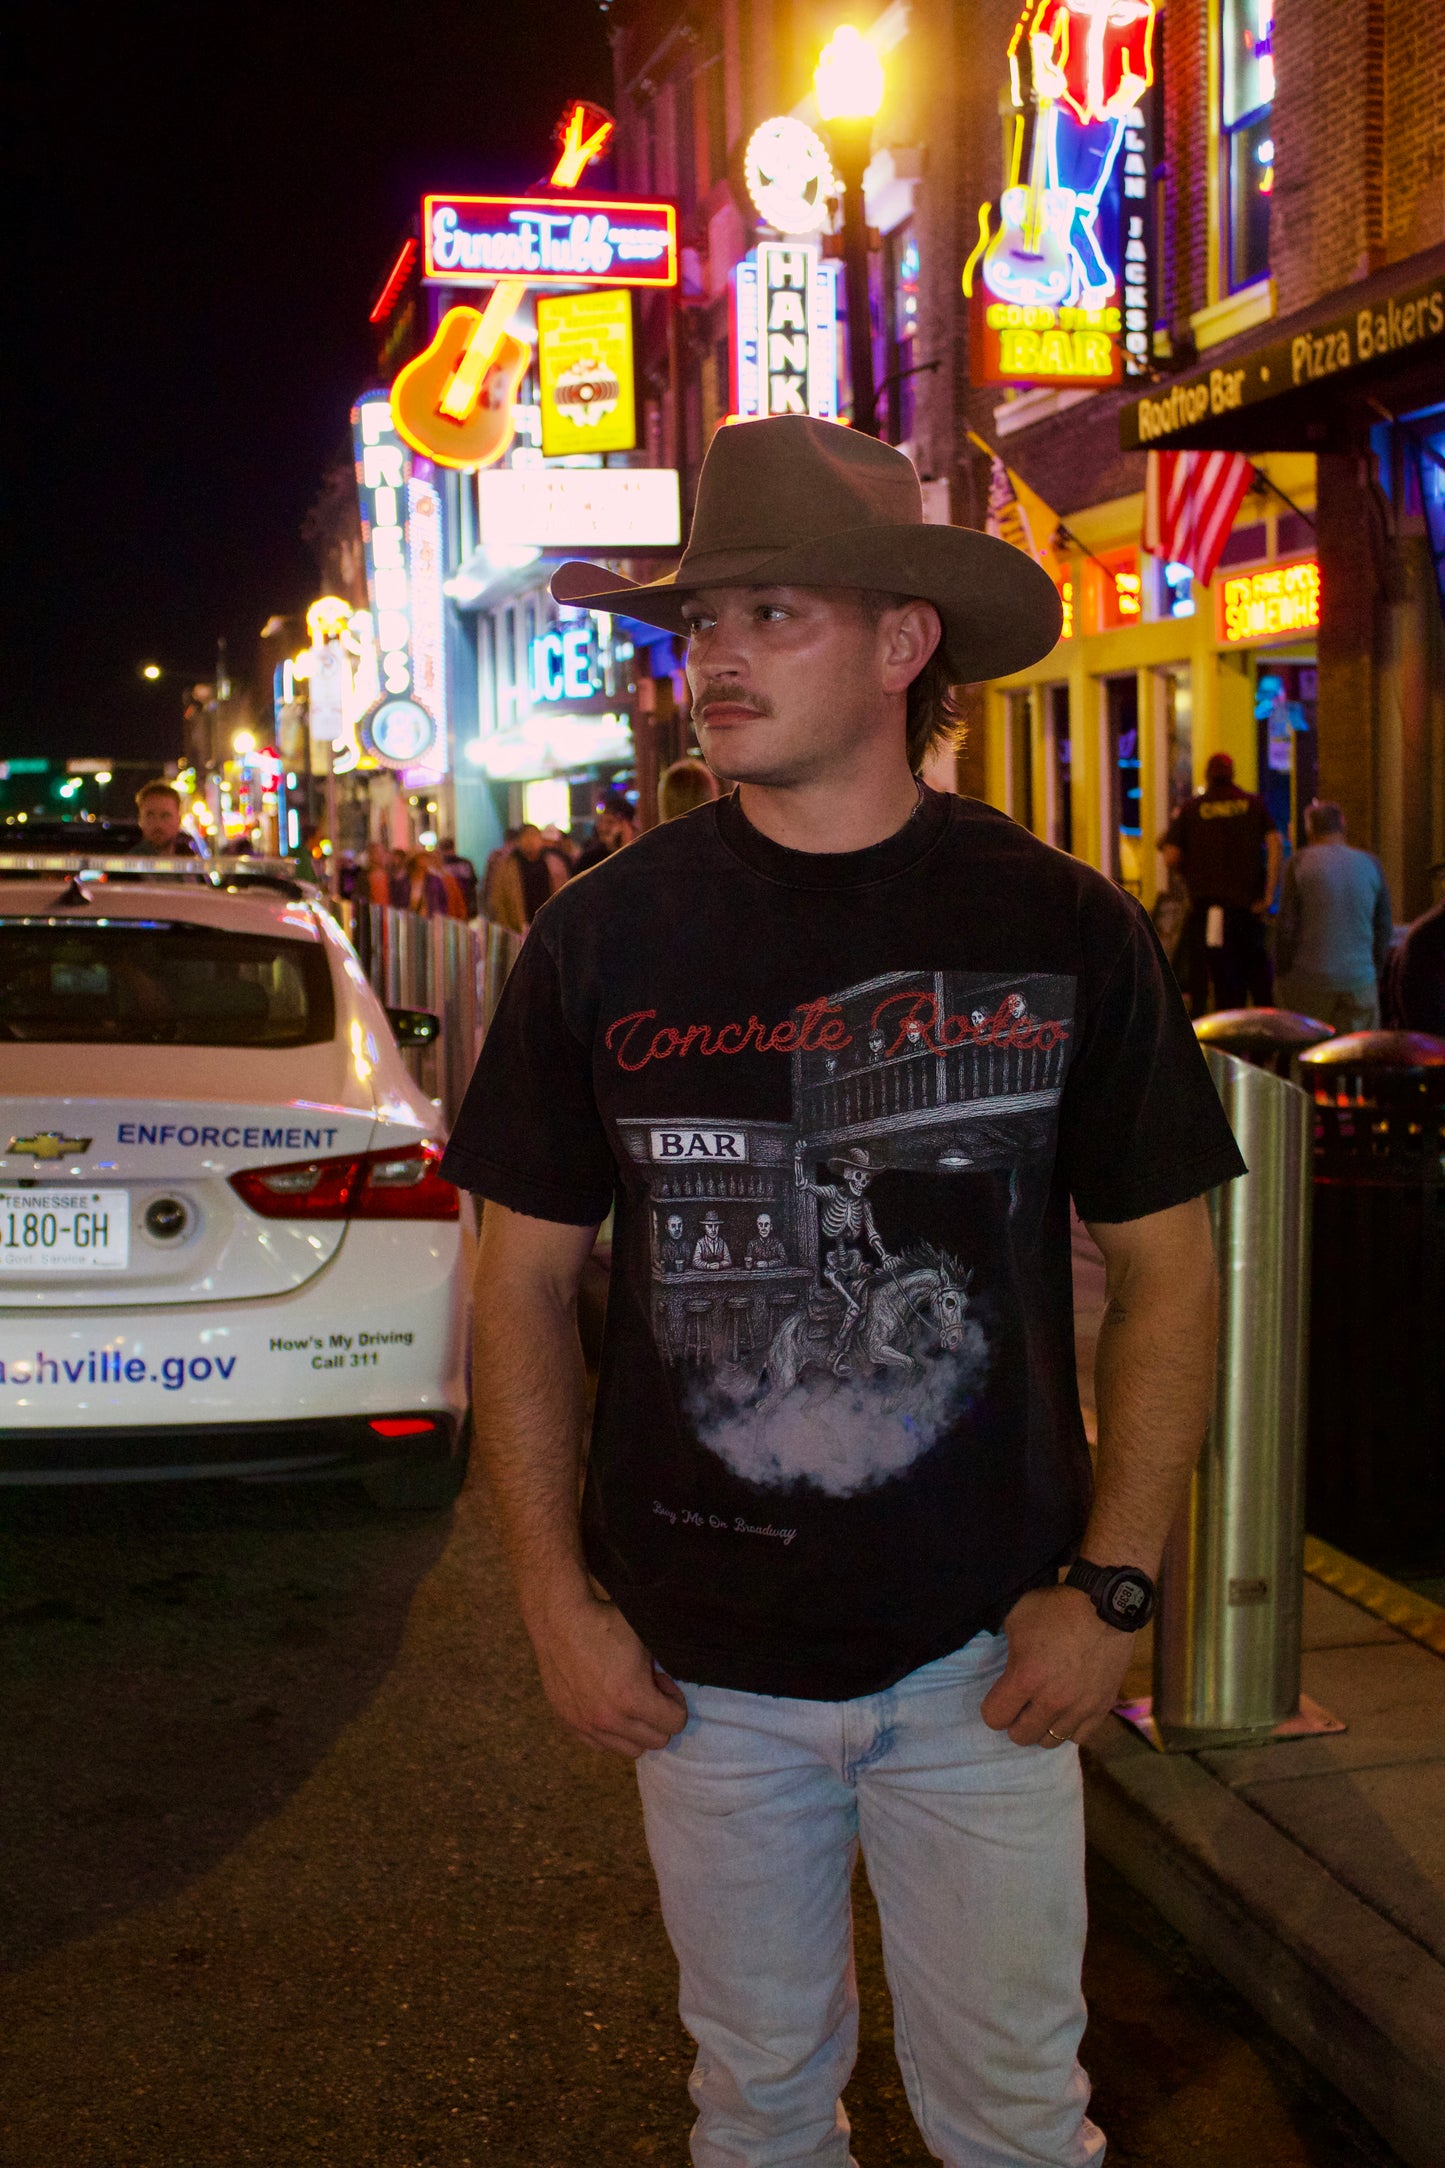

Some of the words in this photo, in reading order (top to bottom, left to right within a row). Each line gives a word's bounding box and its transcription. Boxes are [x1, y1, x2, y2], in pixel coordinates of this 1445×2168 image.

[432, 207, 540, 271] Ernest
[509, 210, 614, 273] Tubb
[768, 251, 807, 414] HANK
[999, 329, 1113, 376] BAR
[1137, 383, 1210, 442] Rooftop
[1210, 368, 1246, 415] Bar
[1291, 330, 1351, 385] Pizza
[1356, 291, 1444, 360] Bakers
[605, 996, 853, 1072] Concrete
[870, 992, 1069, 1058] Rodeo
[117, 1123, 338, 1149] ENFORCEMENT
[659, 1132, 741, 1159] BAR
[6, 1196, 88, 1209] TENNESSEE
[0, 1212, 109, 1248] 180-GH
[41, 1254, 86, 1265] Service
[269, 1335, 323, 1351] How's
[329, 1334, 352, 1350] My
[358, 1331, 414, 1346] Driving
[311, 1354, 344, 1370] Call
[350, 1352, 379, 1367] 311
[681, 1509, 705, 1527] Me
[708, 1514, 729, 1529] On
[733, 1517, 799, 1545] Broadway
